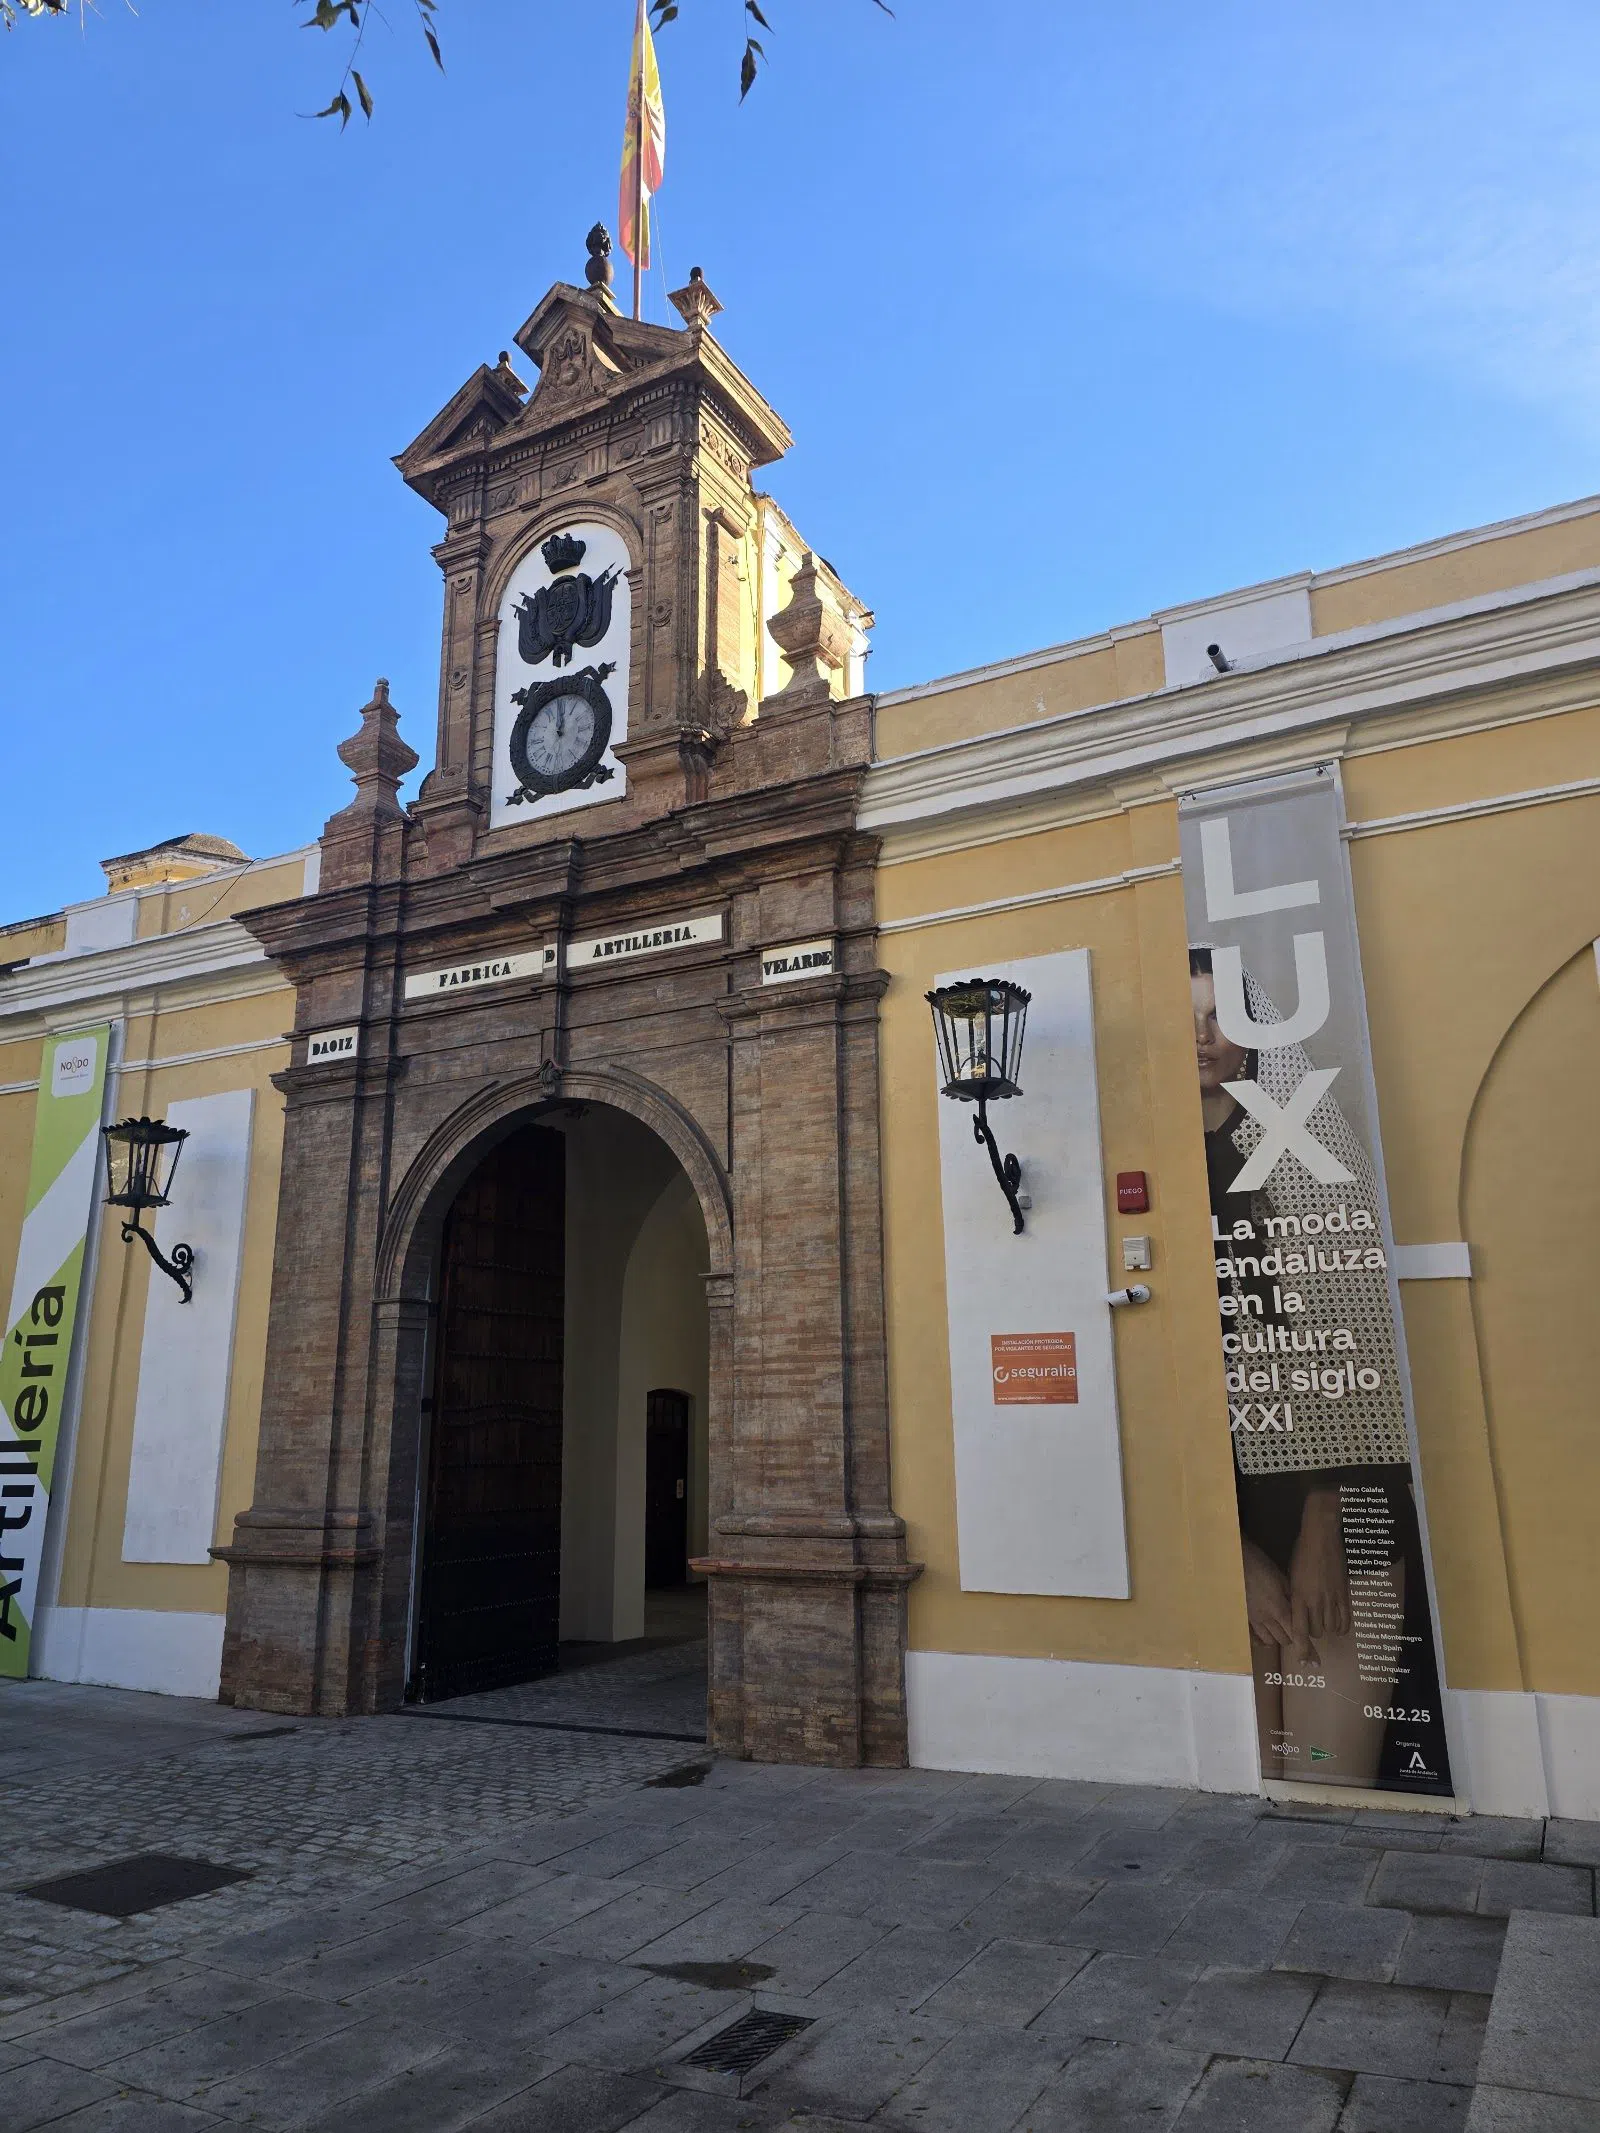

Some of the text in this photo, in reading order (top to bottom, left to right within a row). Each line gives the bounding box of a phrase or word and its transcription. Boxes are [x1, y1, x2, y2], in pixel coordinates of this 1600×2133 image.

[762, 951, 832, 976] VELARDE
[439, 961, 512, 988] FABRICA
[1200, 817, 1357, 1193] LUX
[312, 1036, 353, 1055] DAOIZ
[1119, 1187, 1143, 1195] FUEGO
[1211, 1203, 1375, 1241] La moda
[1215, 1244, 1387, 1279] andaluza
[1218, 1285, 1306, 1316] en la
[1222, 1324, 1357, 1354] cultura
[1011, 1363, 1076, 1378] seguralia
[1225, 1360, 1381, 1400] del siglo
[1229, 1403, 1294, 1432] XXI
[1339, 1485, 1360, 1493] Álvaro
[1361, 1548, 1389, 1556] Domecq
[1371, 1601, 1400, 1609] Concept
[1356, 1642, 1402, 1652] Palomo Spain
[1380, 1633, 1423, 1643] Montenegro
[1264, 1672, 1326, 1688] 29.10.25
[1360, 1674, 1387, 1682] Roberto
[1363, 1705, 1431, 1723] 08.12.25
